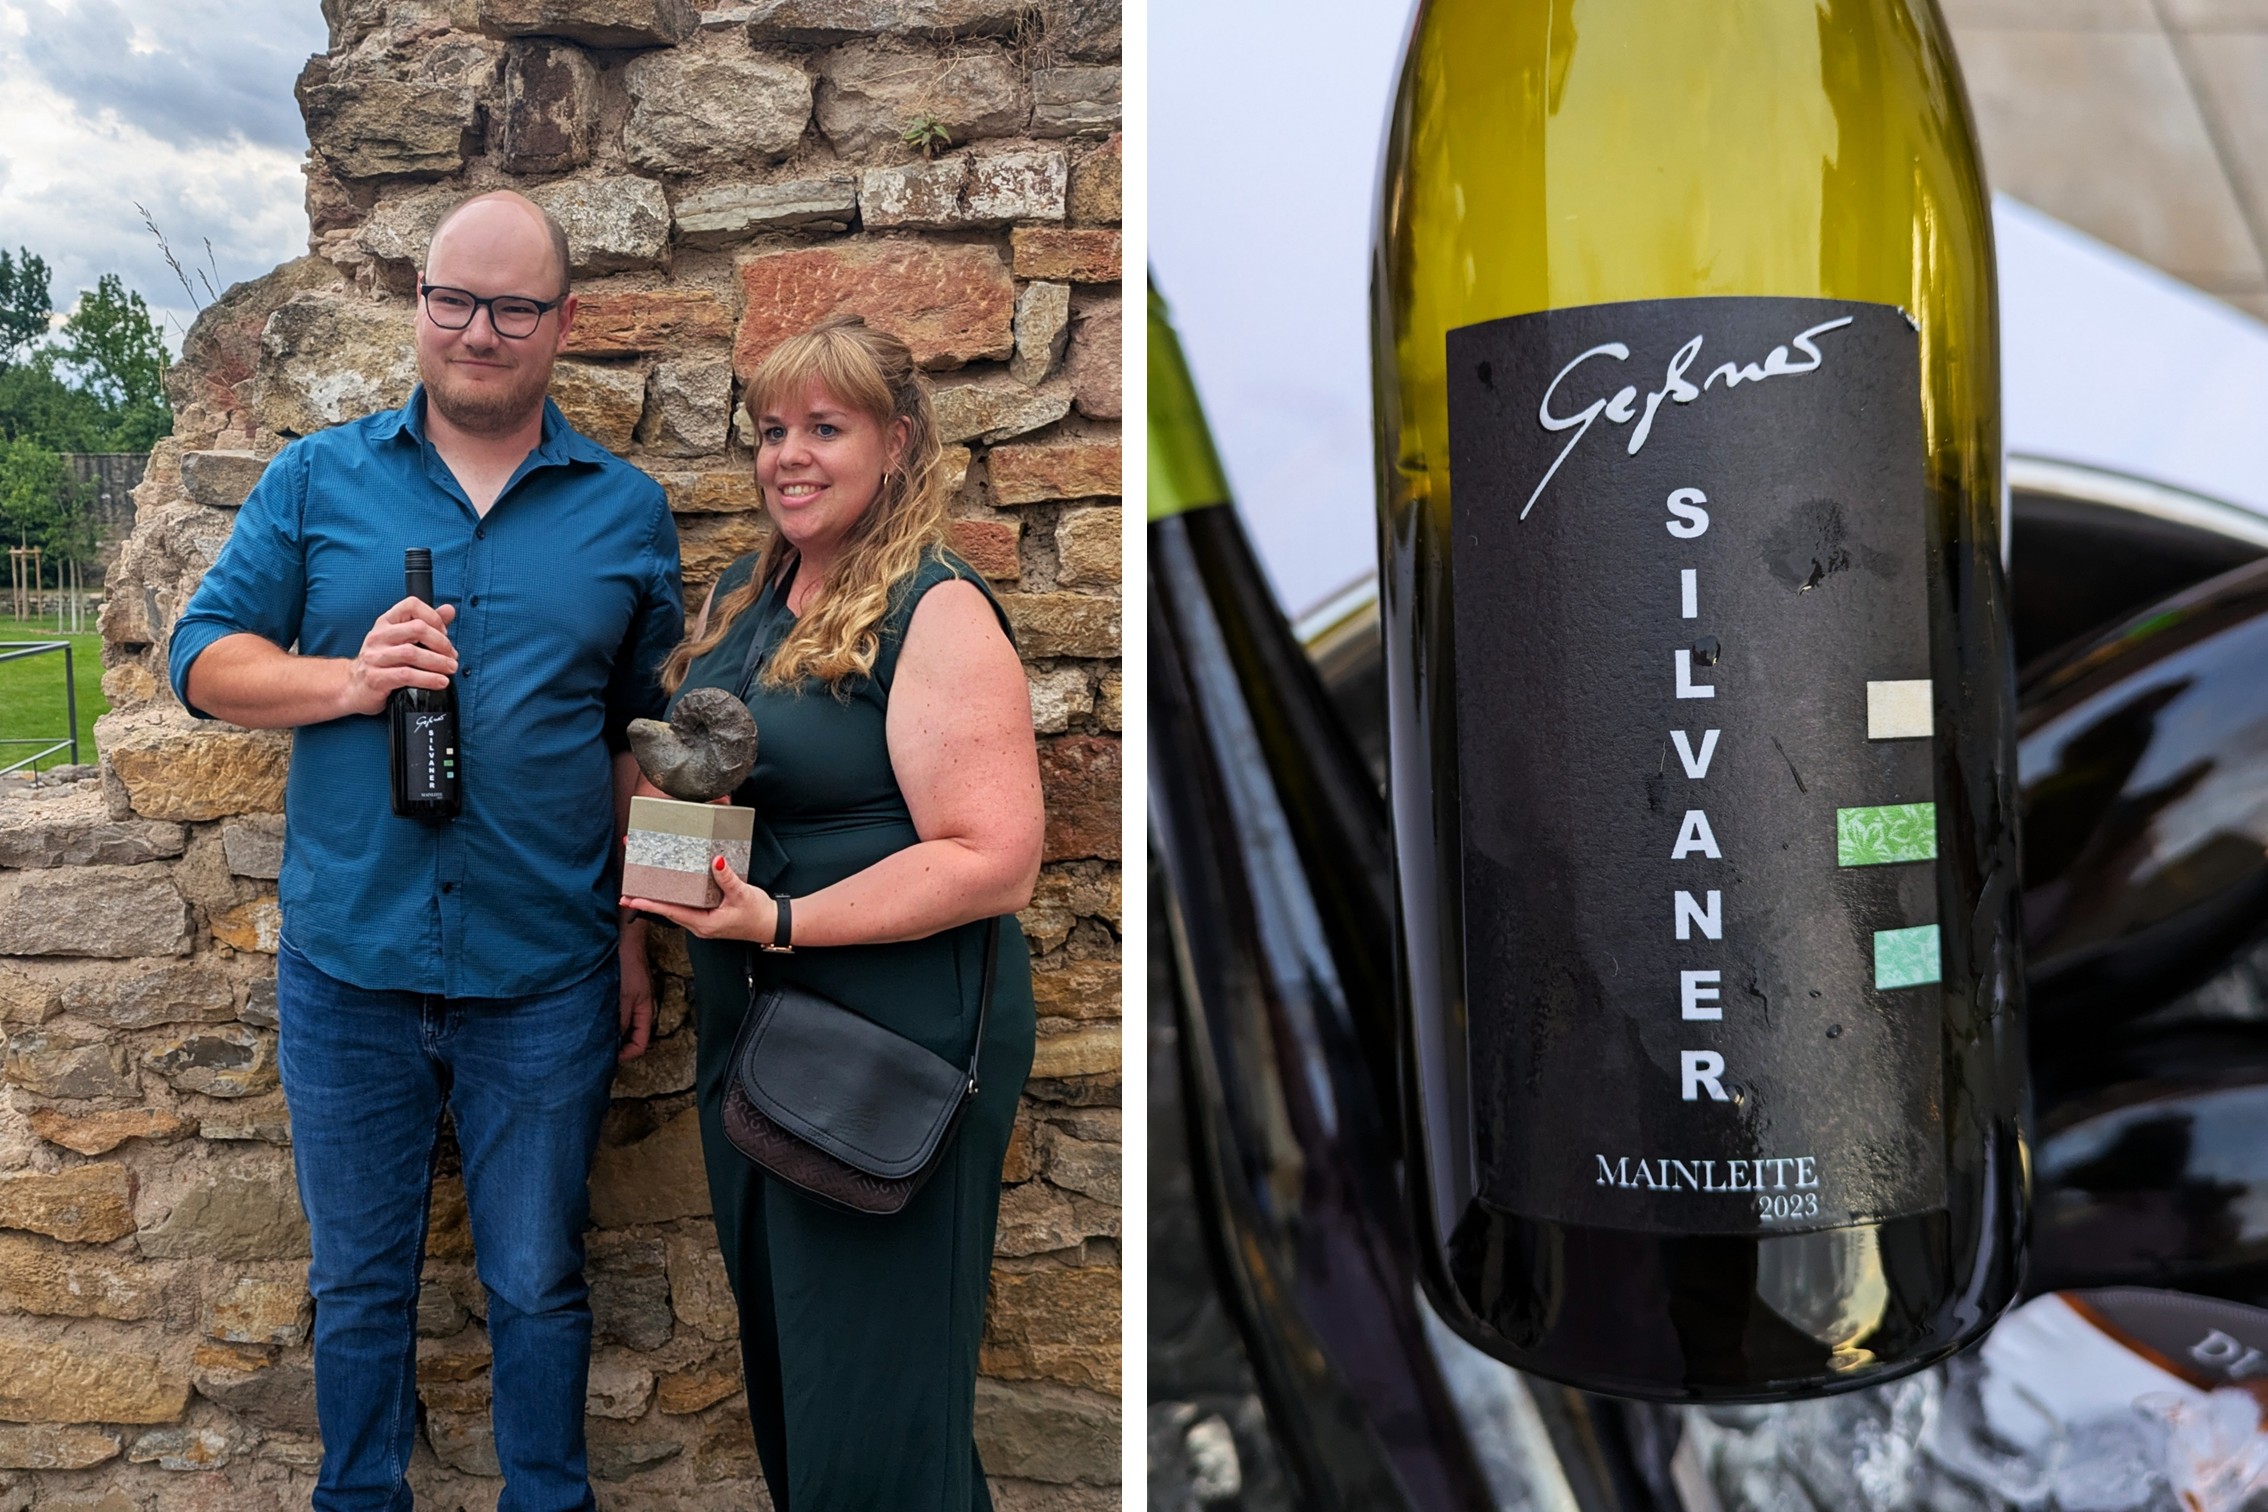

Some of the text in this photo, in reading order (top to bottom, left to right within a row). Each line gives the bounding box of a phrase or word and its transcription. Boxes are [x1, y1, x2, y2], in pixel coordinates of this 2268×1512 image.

[428, 729, 436, 789] SILVANER
[1665, 487, 1730, 1101] SILVANER
[1595, 1154, 1819, 1192] MAINLEITE
[1758, 1193, 1819, 1221] 2023
